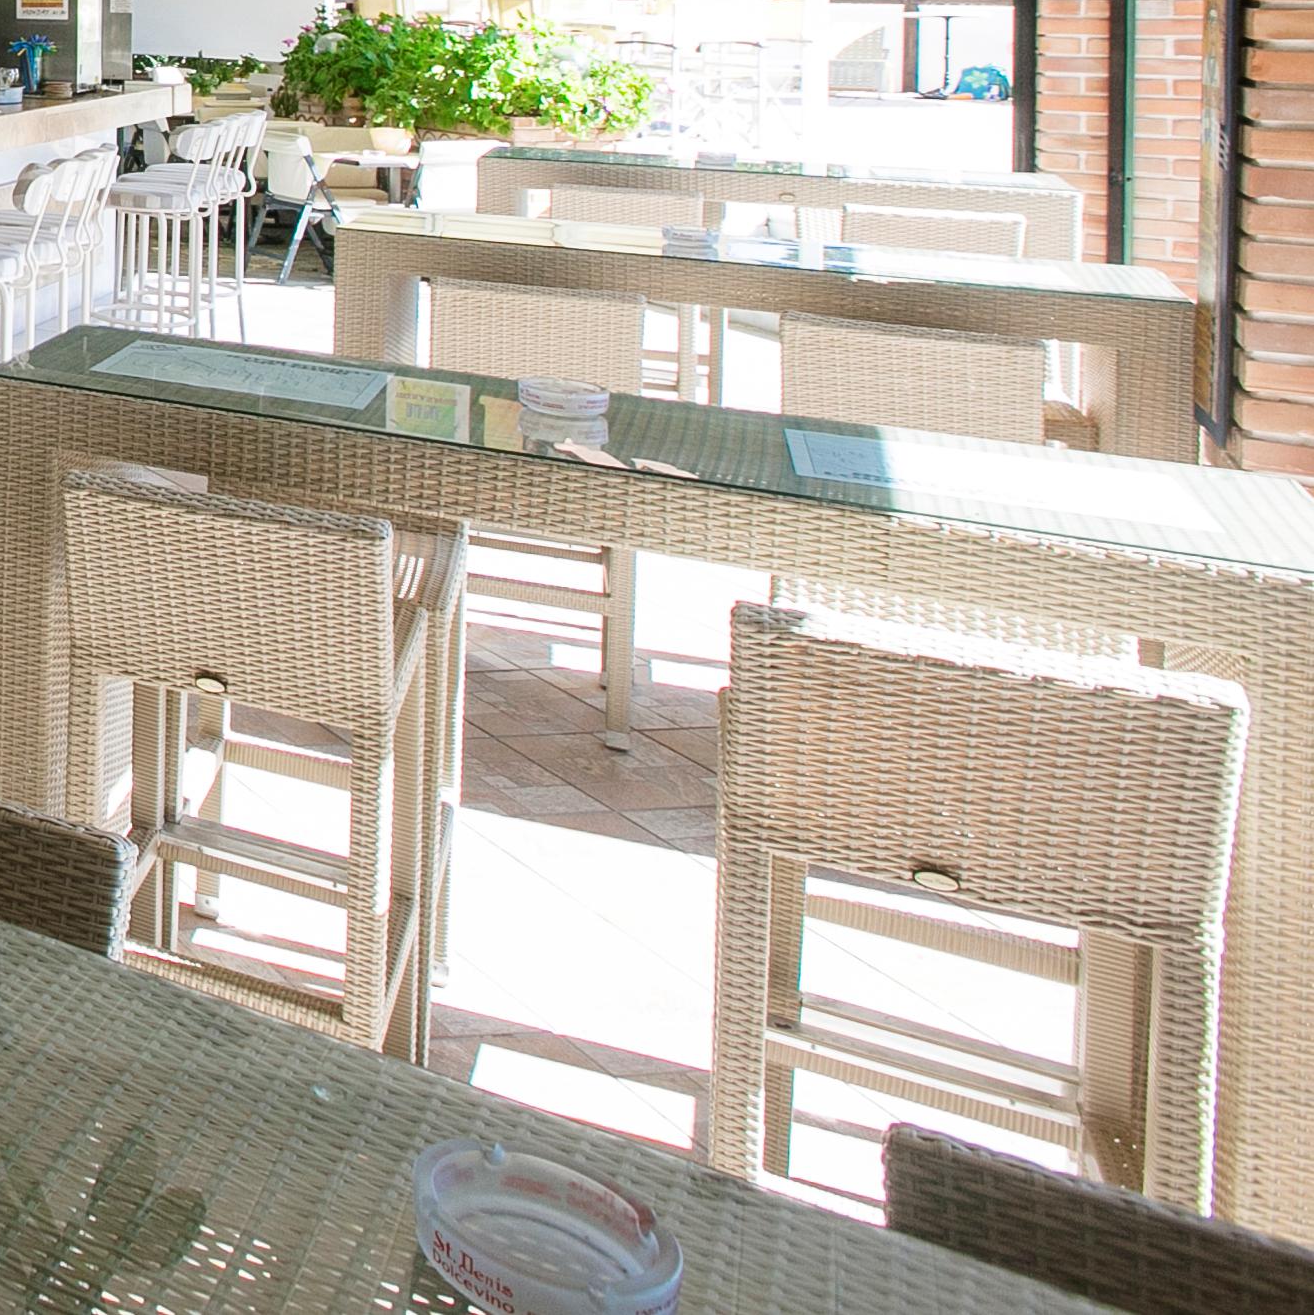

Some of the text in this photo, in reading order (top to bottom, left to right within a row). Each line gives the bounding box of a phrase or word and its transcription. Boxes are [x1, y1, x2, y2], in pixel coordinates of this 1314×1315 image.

[432, 1229, 514, 1299] St. Denis
[432, 1247, 515, 1315] Dolcevino
